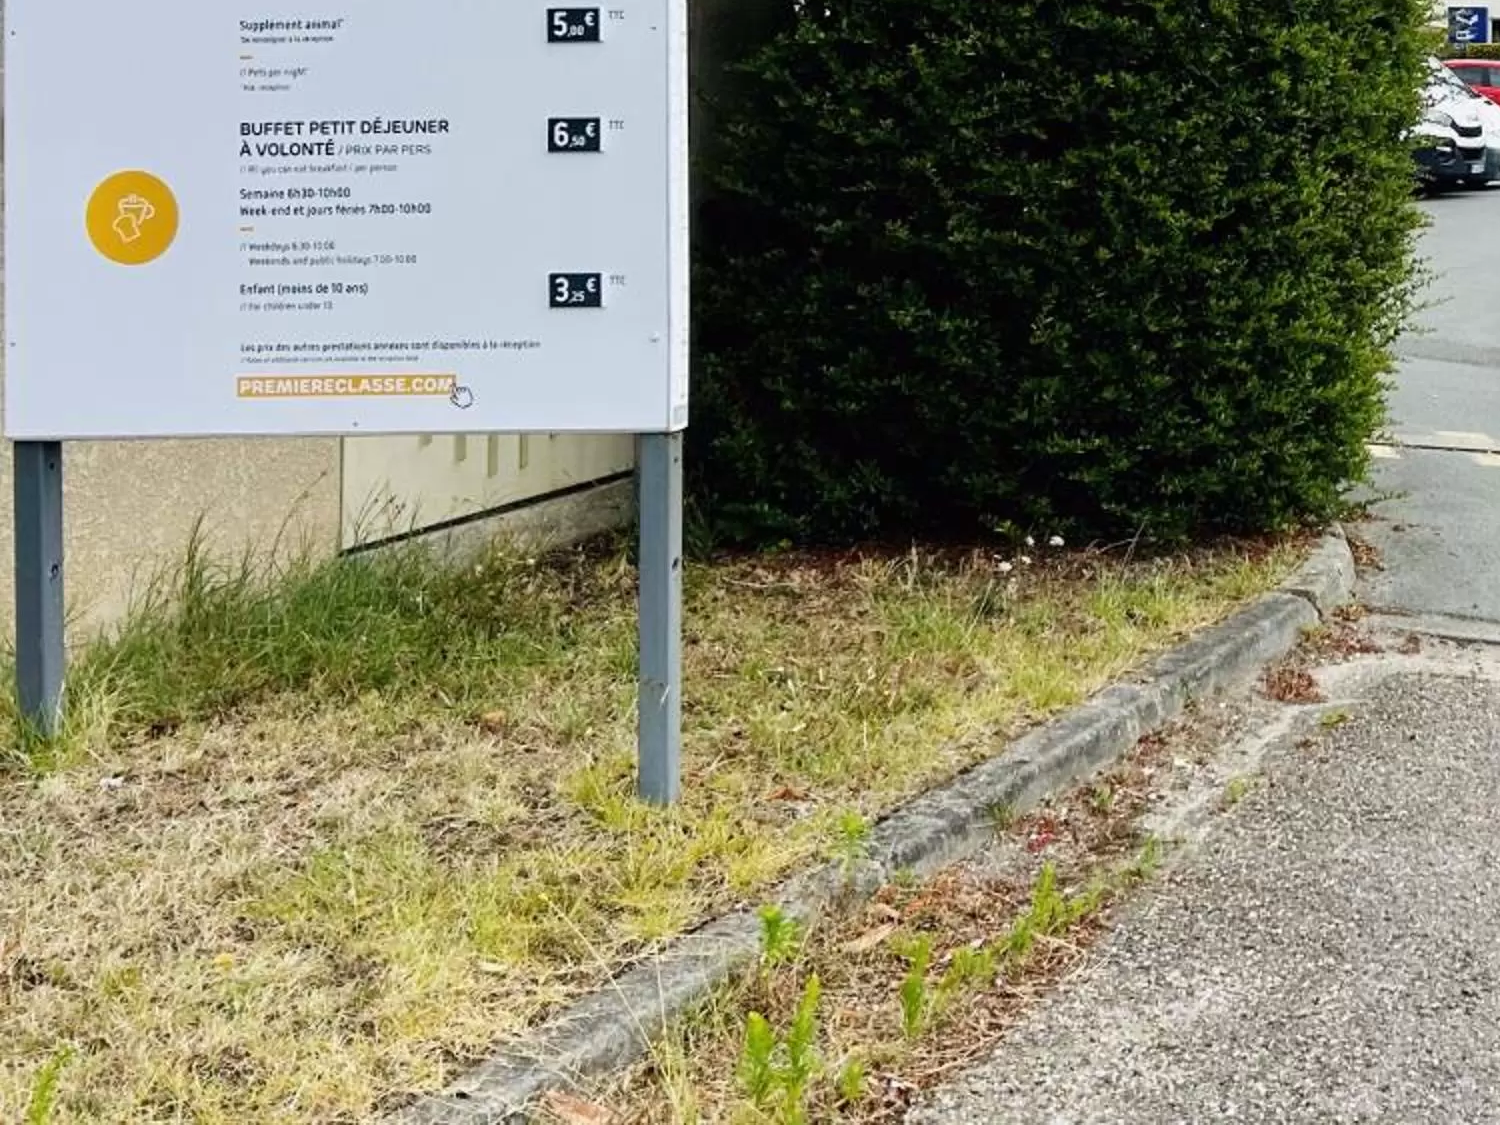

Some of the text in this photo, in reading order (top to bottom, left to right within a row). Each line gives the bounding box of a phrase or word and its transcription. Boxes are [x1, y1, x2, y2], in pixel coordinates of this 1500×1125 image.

[240, 117, 449, 136] BUFFET PETIT DÉJEUNER
[240, 140, 251, 156] À
[256, 139, 334, 156] VOLONTÉ
[346, 145, 371, 155] PRIX
[376, 145, 398, 155] PAR
[240, 189, 284, 199] Semaine
[240, 283, 274, 295] Enfant
[316, 283, 328, 293] de
